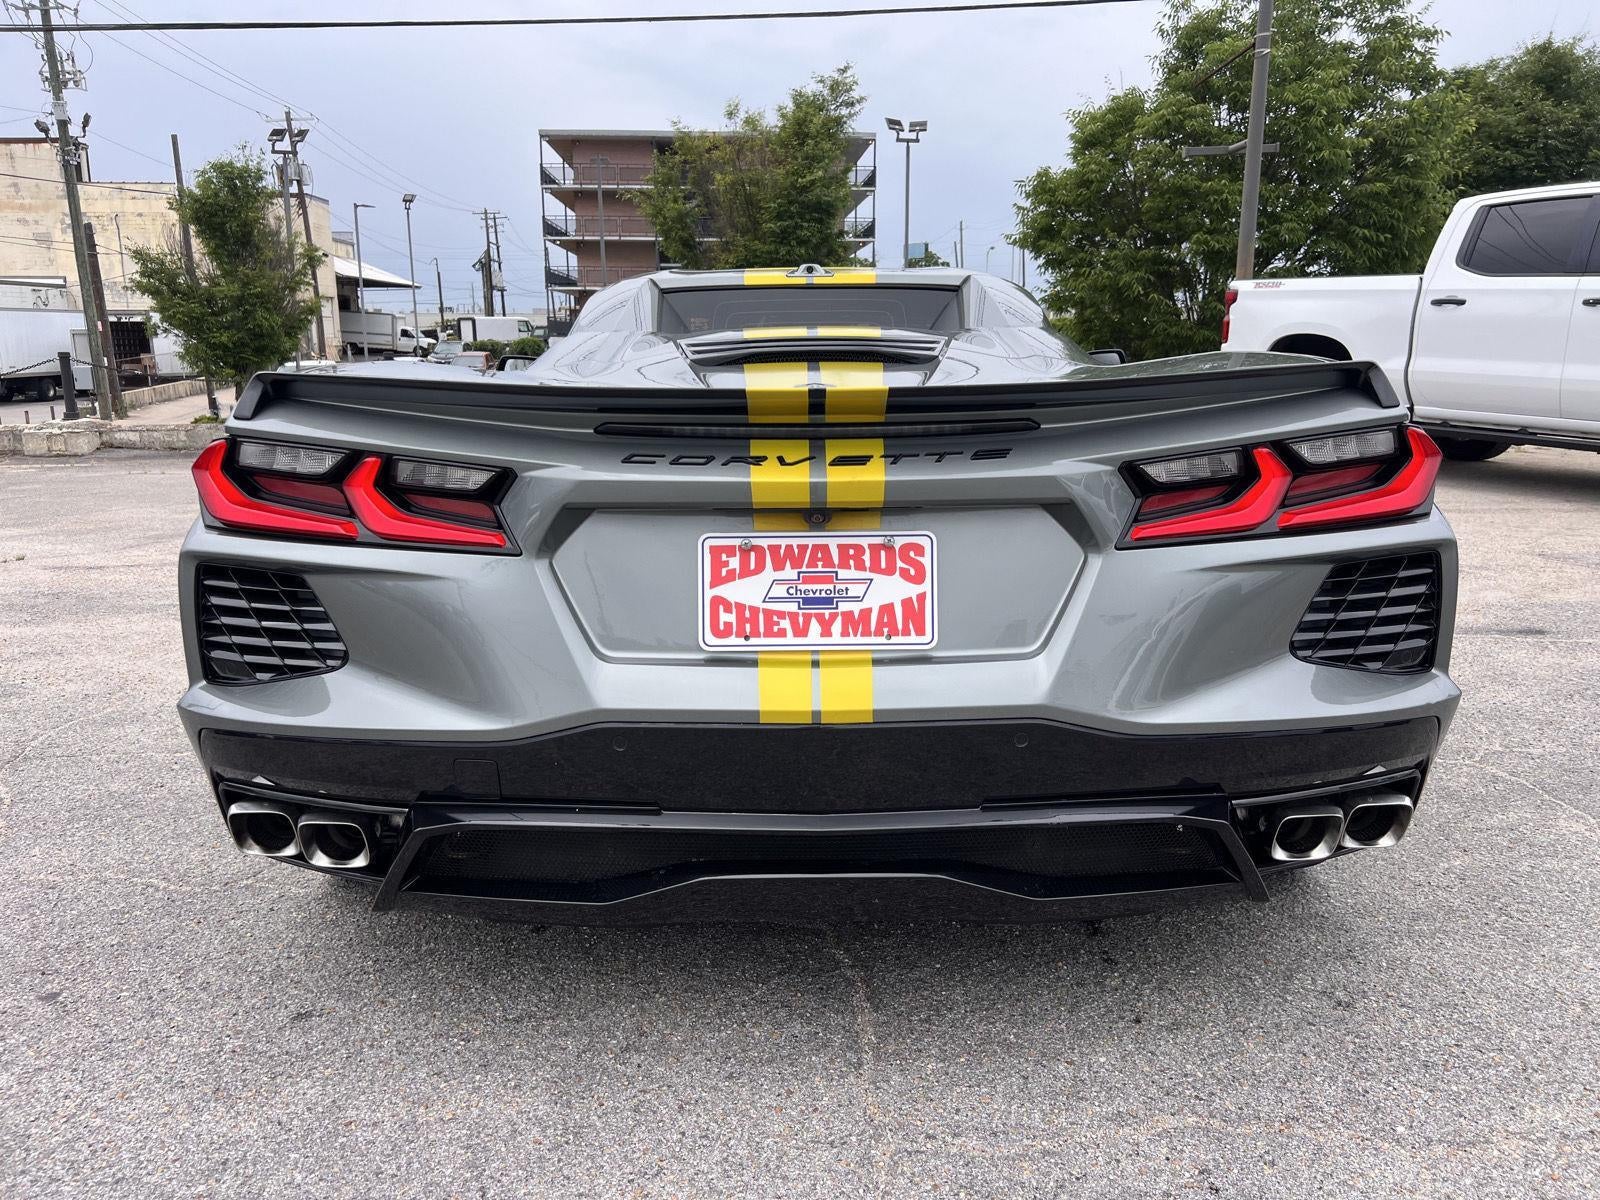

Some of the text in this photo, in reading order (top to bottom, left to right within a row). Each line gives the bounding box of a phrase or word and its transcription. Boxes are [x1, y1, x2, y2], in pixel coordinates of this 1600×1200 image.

[621, 448, 1012, 466] CORVETTE
[709, 542, 926, 589] EDWARDS
[786, 585, 849, 597] Chevrolet
[709, 591, 926, 638] CHEVYMAN
